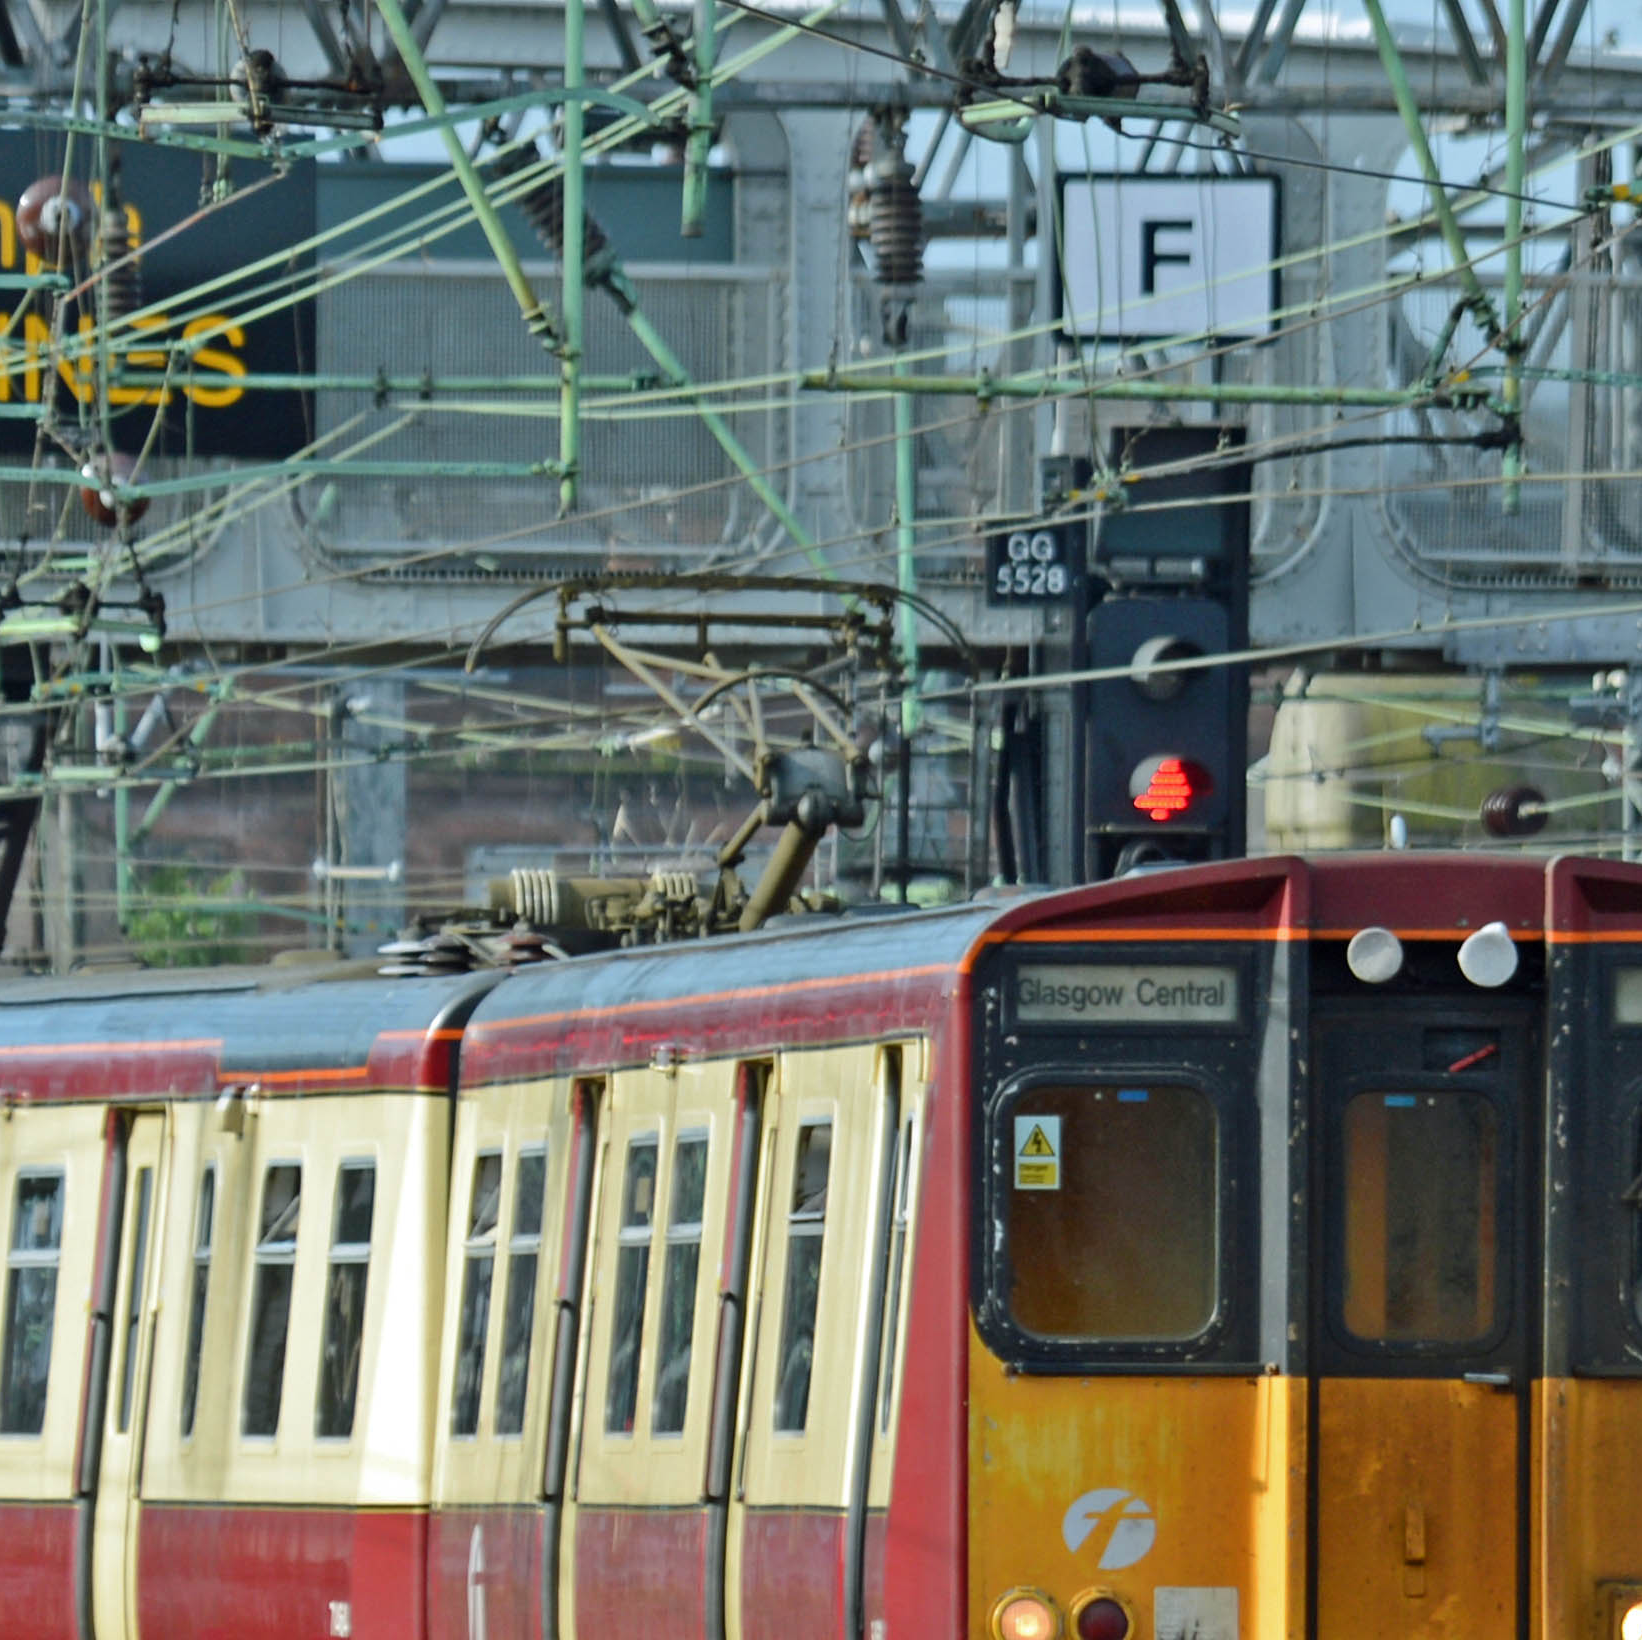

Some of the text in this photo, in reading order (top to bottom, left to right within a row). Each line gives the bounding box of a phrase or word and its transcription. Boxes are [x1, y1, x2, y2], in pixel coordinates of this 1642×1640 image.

[1141, 220, 1193, 297] F
[1008, 531, 1055, 561] GG
[996, 565, 1065, 594] 5528
[1018, 978, 1225, 1013] Glasgow Central
